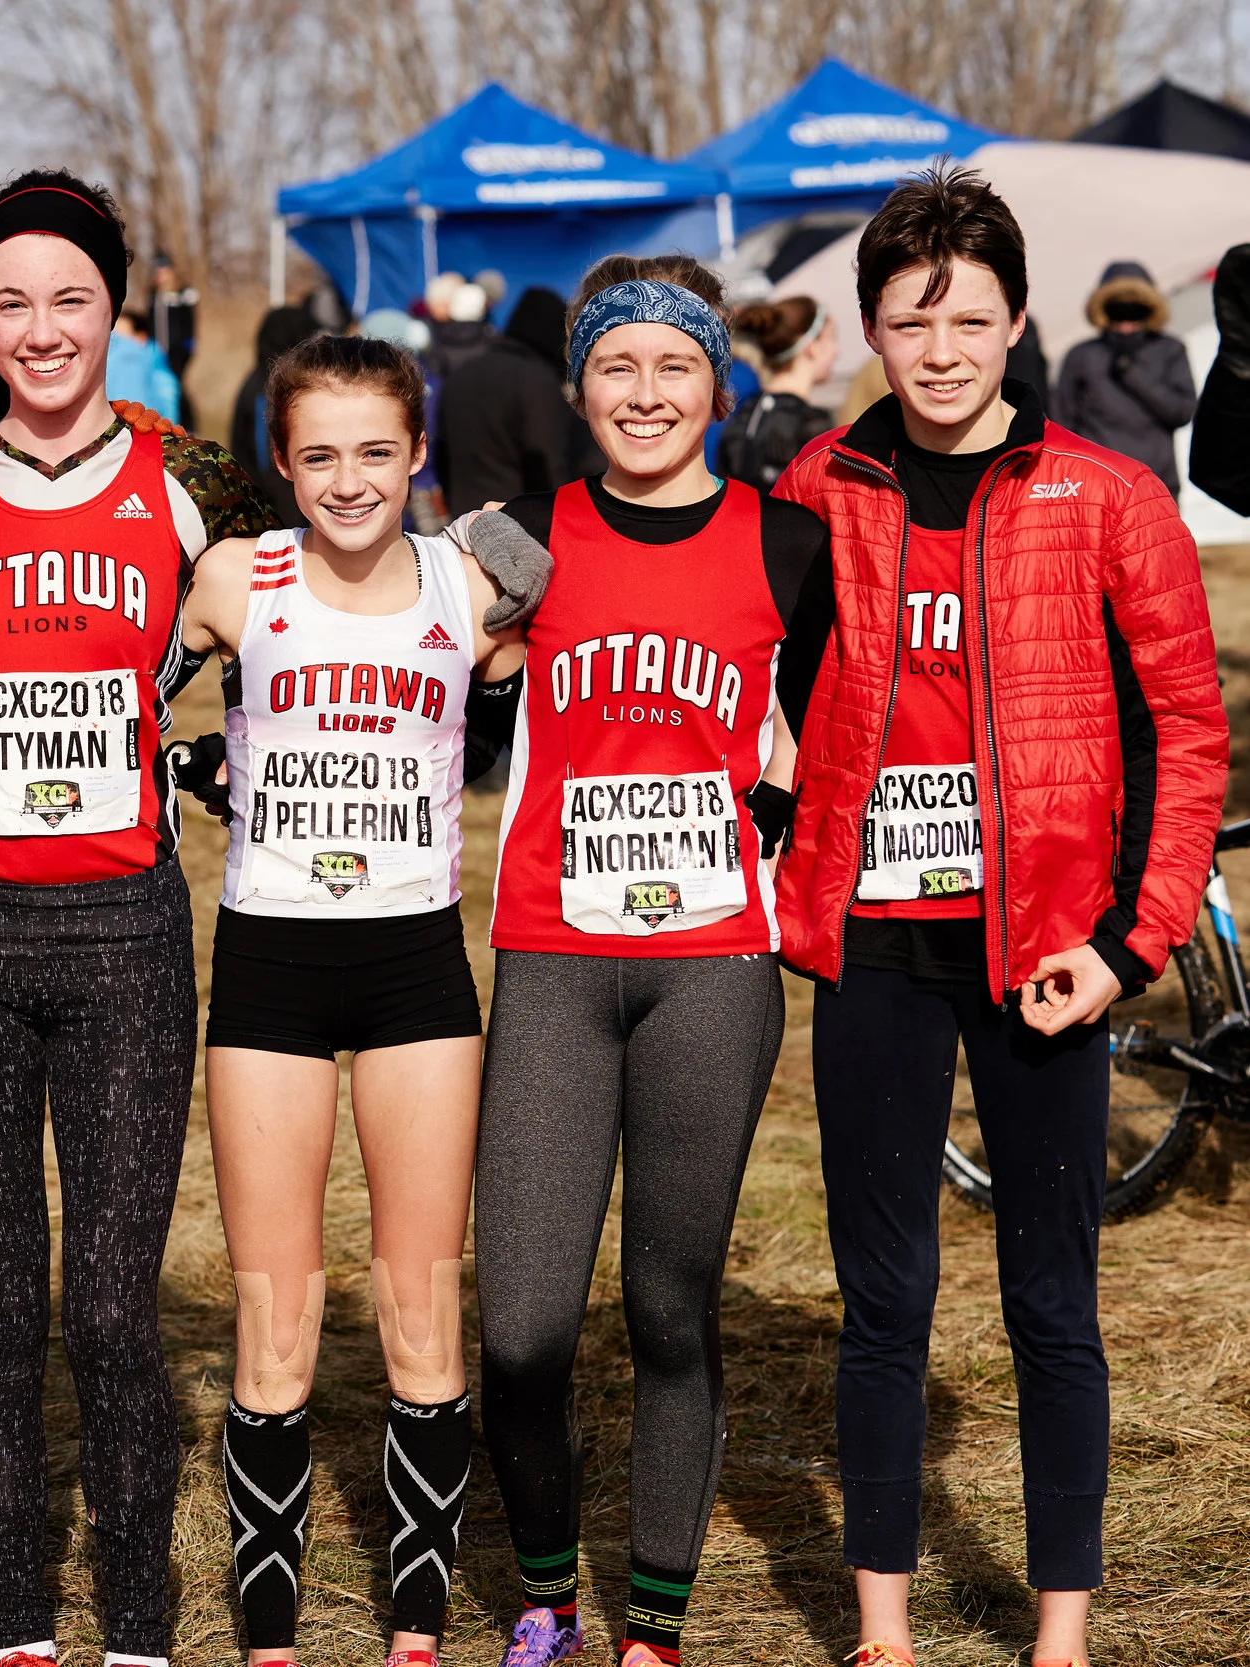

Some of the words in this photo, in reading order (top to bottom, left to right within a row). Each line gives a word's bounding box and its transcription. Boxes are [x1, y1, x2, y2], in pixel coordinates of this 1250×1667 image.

[114, 509, 153, 519] adidas
[7, 615, 88, 634] LIONS
[418, 639, 459, 651] adidas
[270, 662, 447, 724] OTTAWA
[478, 684, 513, 696] XU
[551, 632, 743, 734] OTTAWA
[318, 713, 397, 734] LIONS
[603, 705, 683, 726] LIONS
[129, 721, 138, 768] 1568
[263, 751, 419, 791] ACXC2018
[870, 771, 978, 813] ACXC20
[254, 794, 264, 841] 1554
[276, 801, 408, 842] PELLERIN
[419, 798, 428, 845] 1554
[571, 780, 725, 823] ACXC2018
[586, 830, 716, 874] NORMAN
[728, 822, 737, 869] 1551
[866, 821, 874, 868] 1545
[883, 818, 983, 864] MACDONA
[391, 1398, 439, 1419] 2XU
